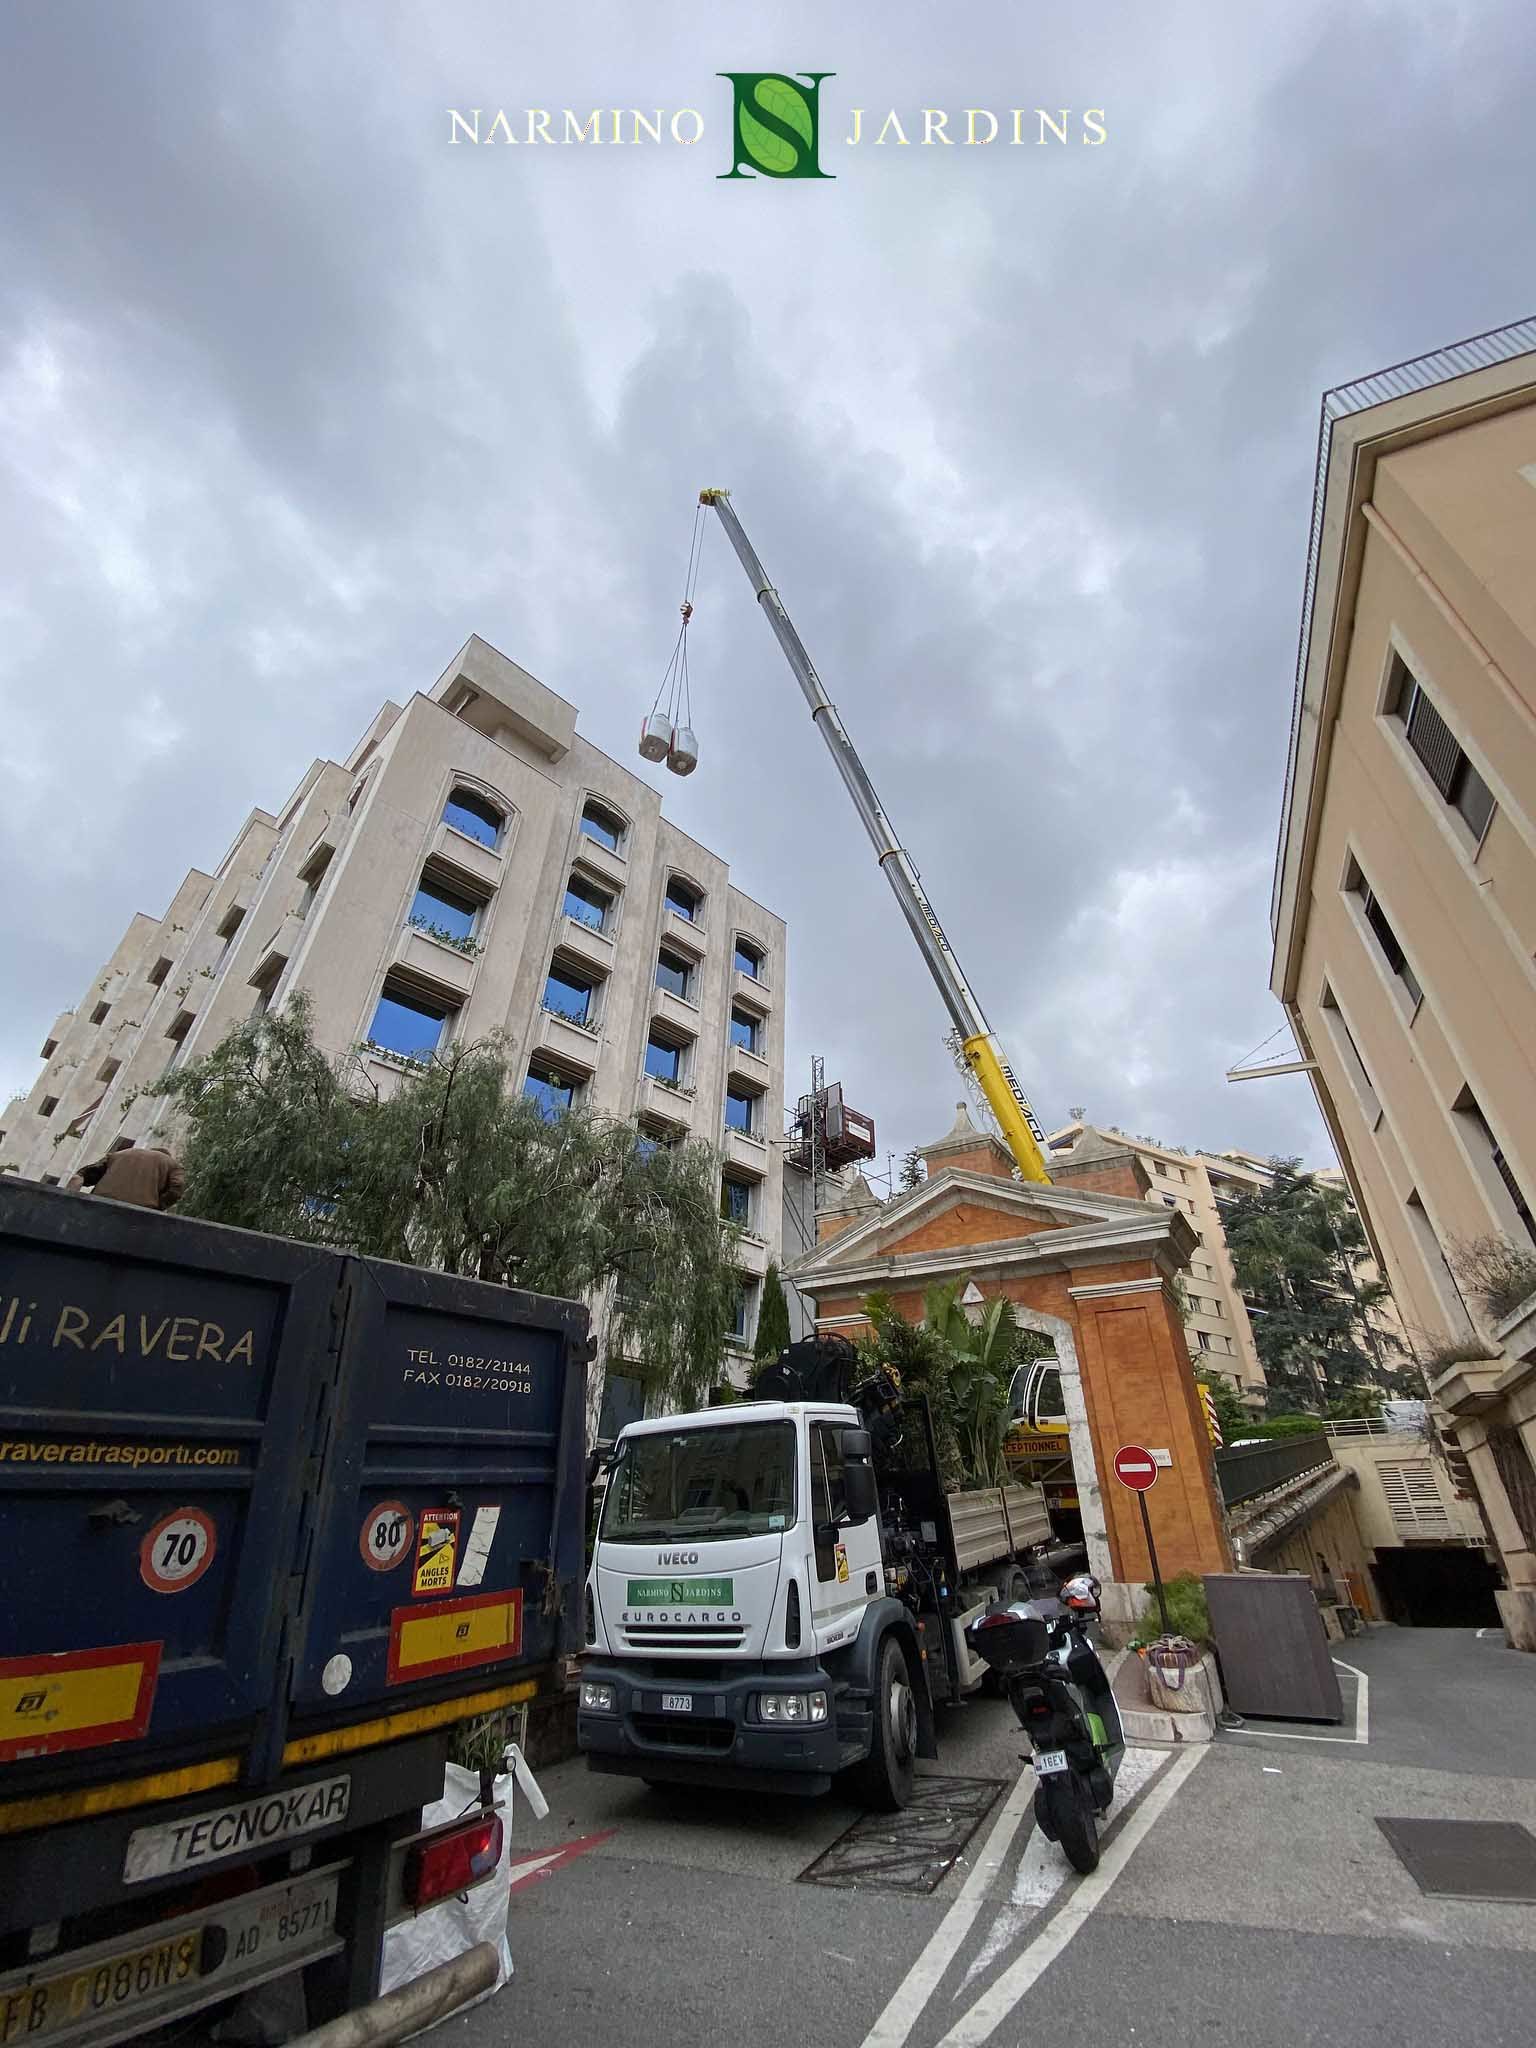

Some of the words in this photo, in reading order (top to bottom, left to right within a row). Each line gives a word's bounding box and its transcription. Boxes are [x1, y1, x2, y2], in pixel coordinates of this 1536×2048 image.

[52, 1305, 253, 1366] RAVERA
[407, 1349, 442, 1366] TEL.
[448, 1354, 530, 1375] 0182/21144
[403, 1369, 441, 1385] FAX
[445, 1373, 531, 1393] 0182/20918
[423, 1512, 458, 1521] ATTENTION
[375, 1520, 400, 1548] 80
[161, 1533, 197, 1567] 70
[657, 1552, 699, 1566] IVECO
[420, 1566, 449, 1578] ANGLES
[420, 1576, 447, 1587] MORTS
[684, 1587, 721, 1598] JARDINS
[622, 1611, 741, 1623] EUROCARGO
[670, 1696, 690, 1710] 8773
[168, 1782, 349, 1865] TECNOKAR
[235, 1924, 260, 1959] AD
[278, 1897, 330, 1942] 85771
